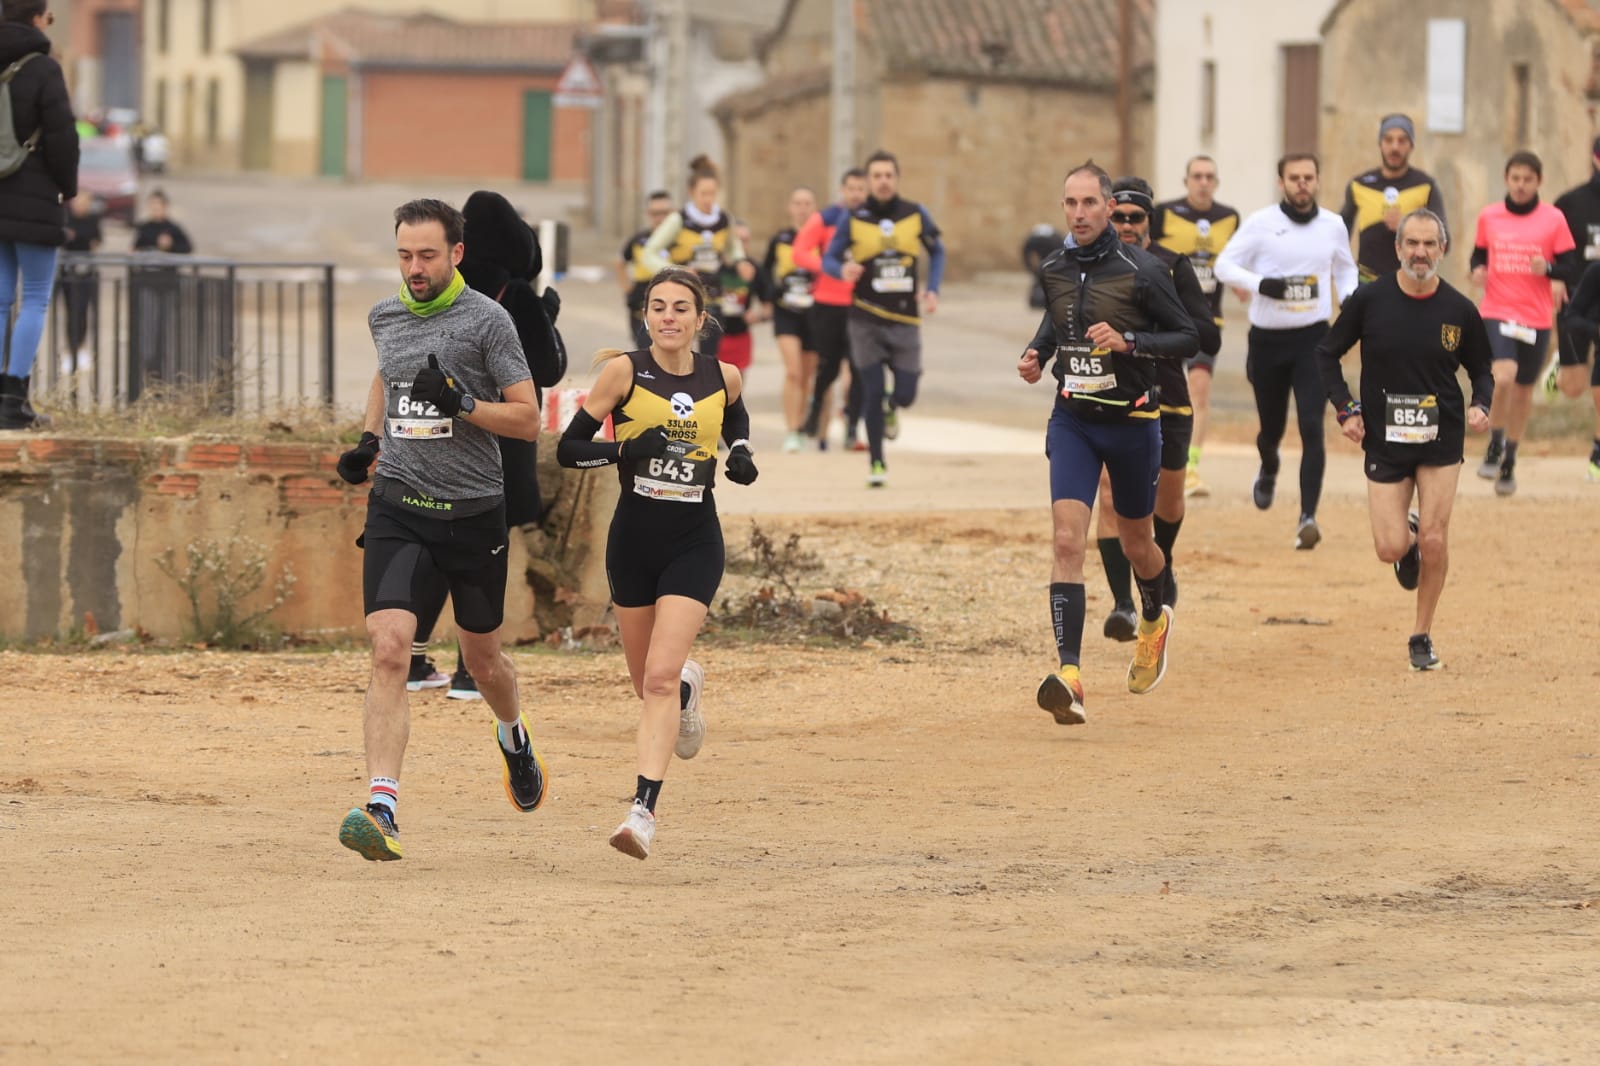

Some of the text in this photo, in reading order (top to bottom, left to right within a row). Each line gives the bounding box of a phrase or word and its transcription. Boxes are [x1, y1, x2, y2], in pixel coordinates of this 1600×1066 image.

[1070, 356, 1103, 375] 645
[398, 395, 439, 417] 642
[1394, 408, 1428, 426] 654
[649, 458, 695, 482] 643
